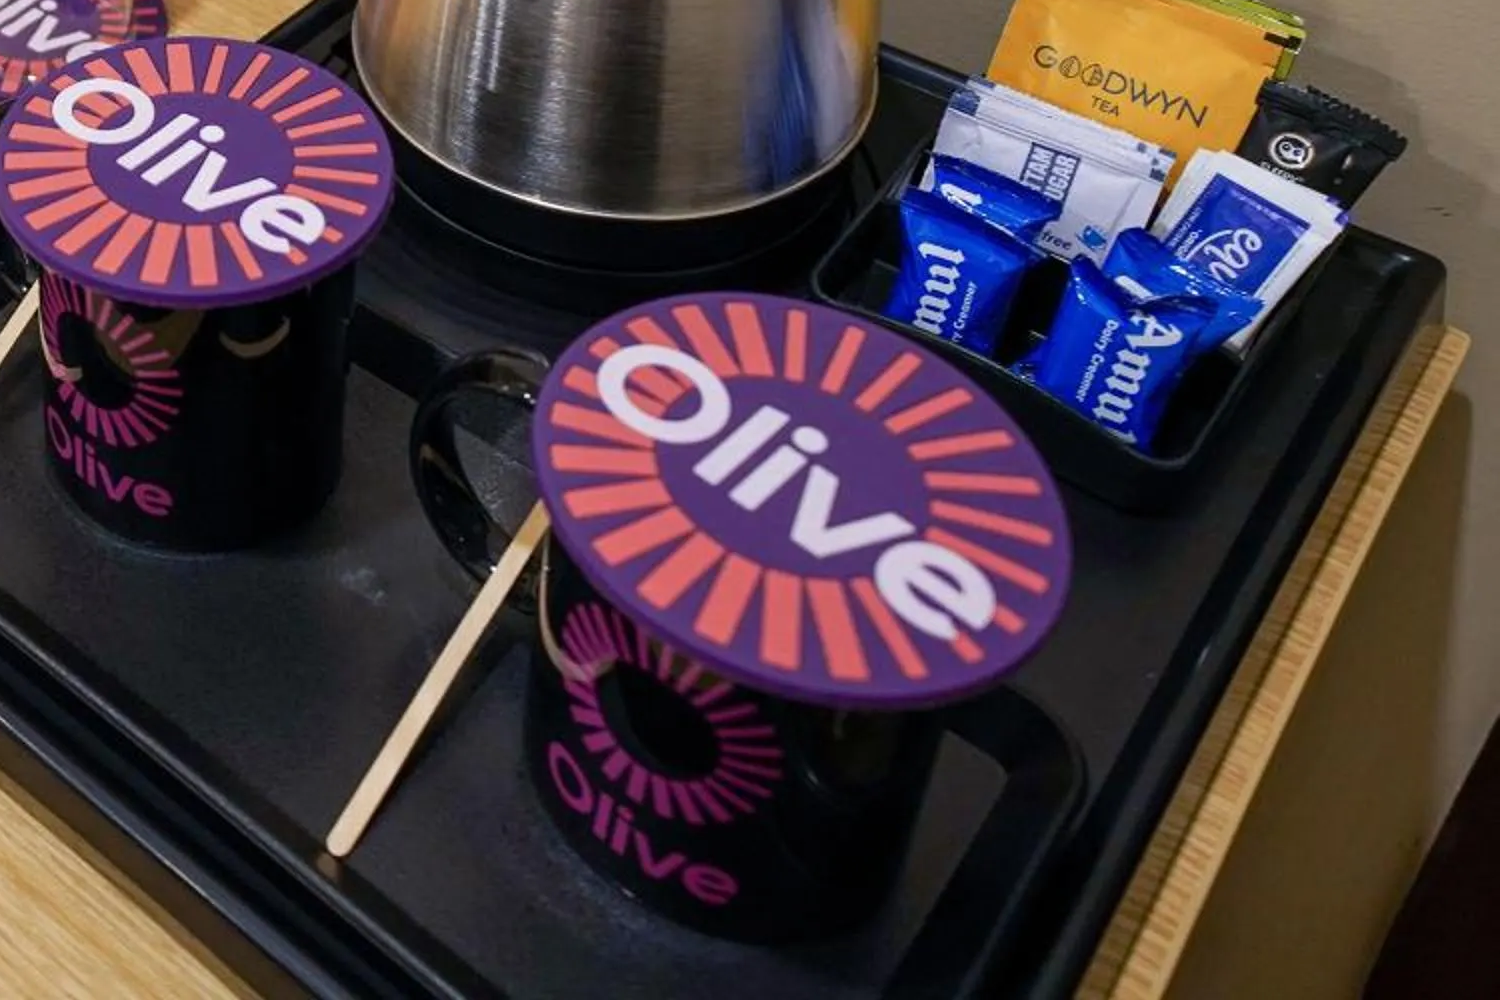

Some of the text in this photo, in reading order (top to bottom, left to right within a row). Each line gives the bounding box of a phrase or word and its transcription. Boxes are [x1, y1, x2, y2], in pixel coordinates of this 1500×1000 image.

[1033, 45, 1209, 129] GOODWYN
[1092, 95, 1120, 117] TEA
[52, 77, 326, 254] Olive
[1043, 154, 1078, 200] UGAR
[912, 242, 965, 336] mul
[1203, 228, 1263, 285] equ
[1093, 319, 1120, 351] Dairy
[46, 405, 173, 516] Olive
[596, 343, 997, 641] Olive
[546, 741, 738, 906] Olive
